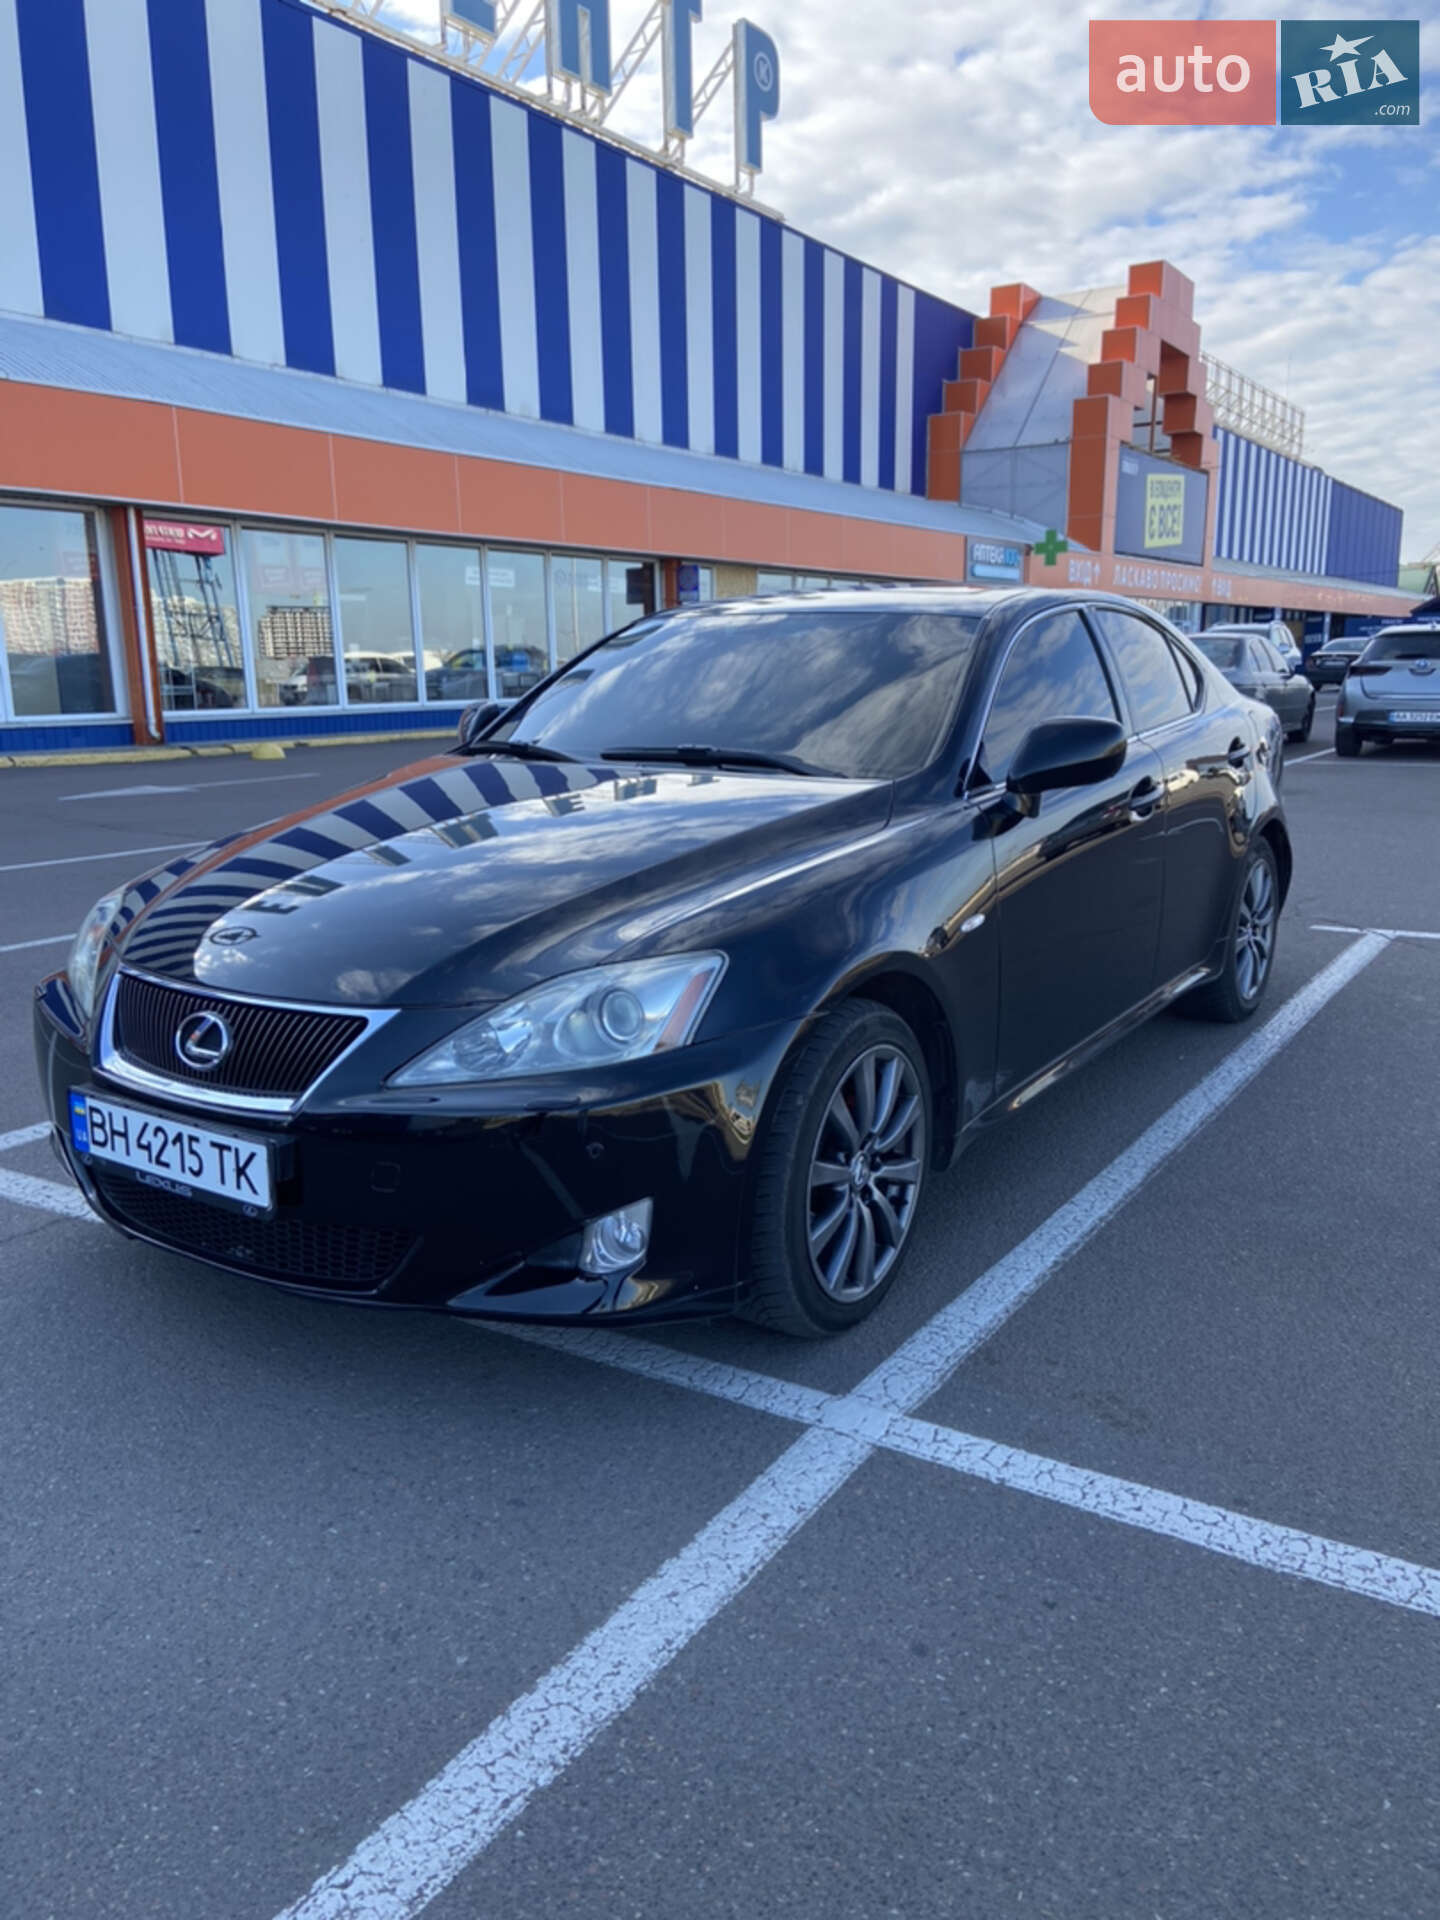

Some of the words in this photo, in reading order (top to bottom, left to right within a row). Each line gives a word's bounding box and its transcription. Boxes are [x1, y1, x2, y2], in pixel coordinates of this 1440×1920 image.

[88, 1105, 131, 1157] BH
[136, 1121, 204, 1178] 4215
[209, 1140, 259, 1196] TK
[135, 1170, 193, 1198] LEXUS
